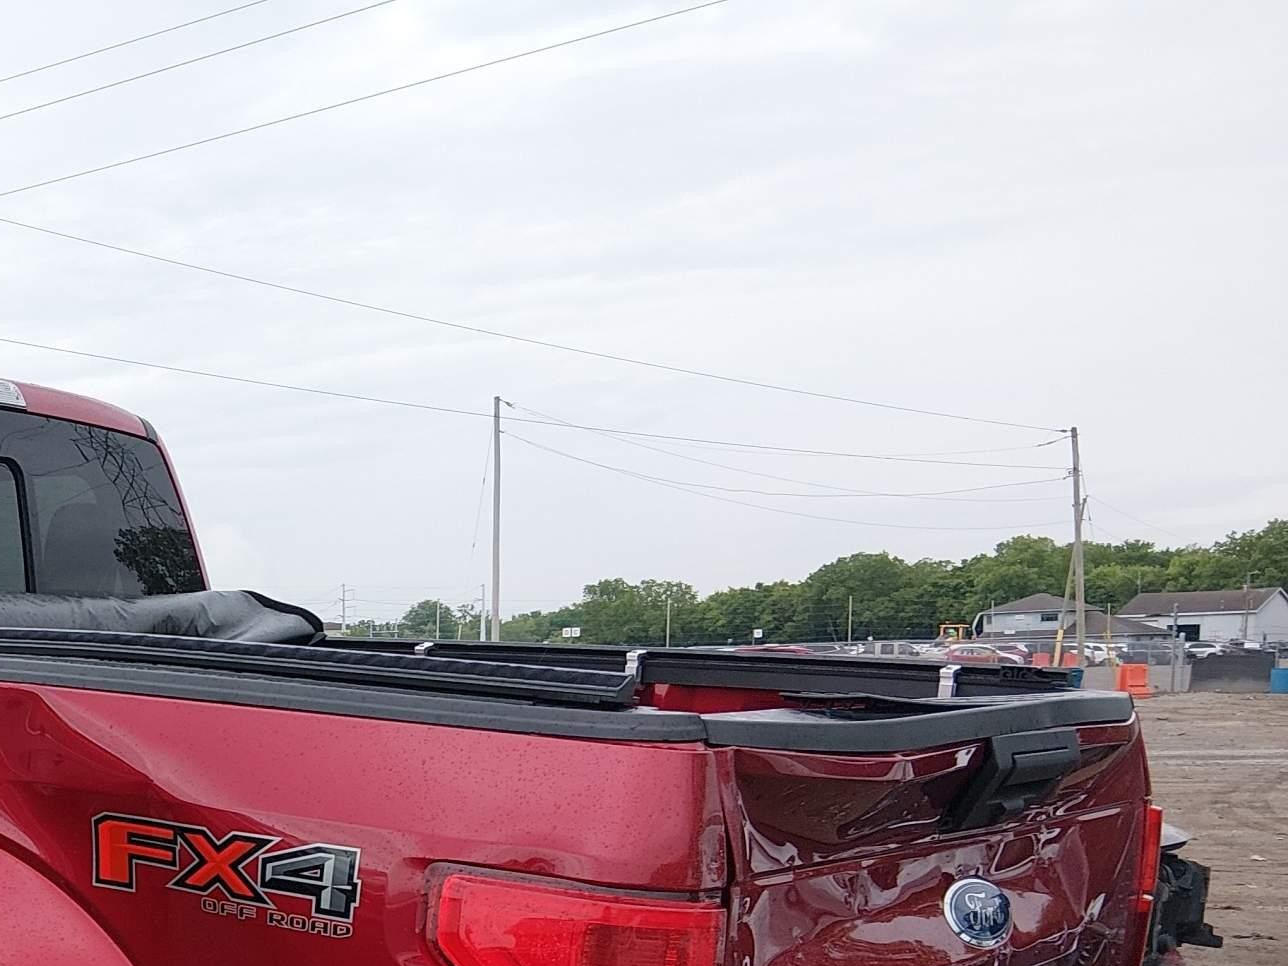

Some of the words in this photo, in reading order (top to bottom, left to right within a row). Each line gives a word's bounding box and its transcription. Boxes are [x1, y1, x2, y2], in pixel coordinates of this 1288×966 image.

[91, 811, 361, 923] FX4
[201, 898, 257, 920] OFF
[267, 909, 353, 939] ROAD
